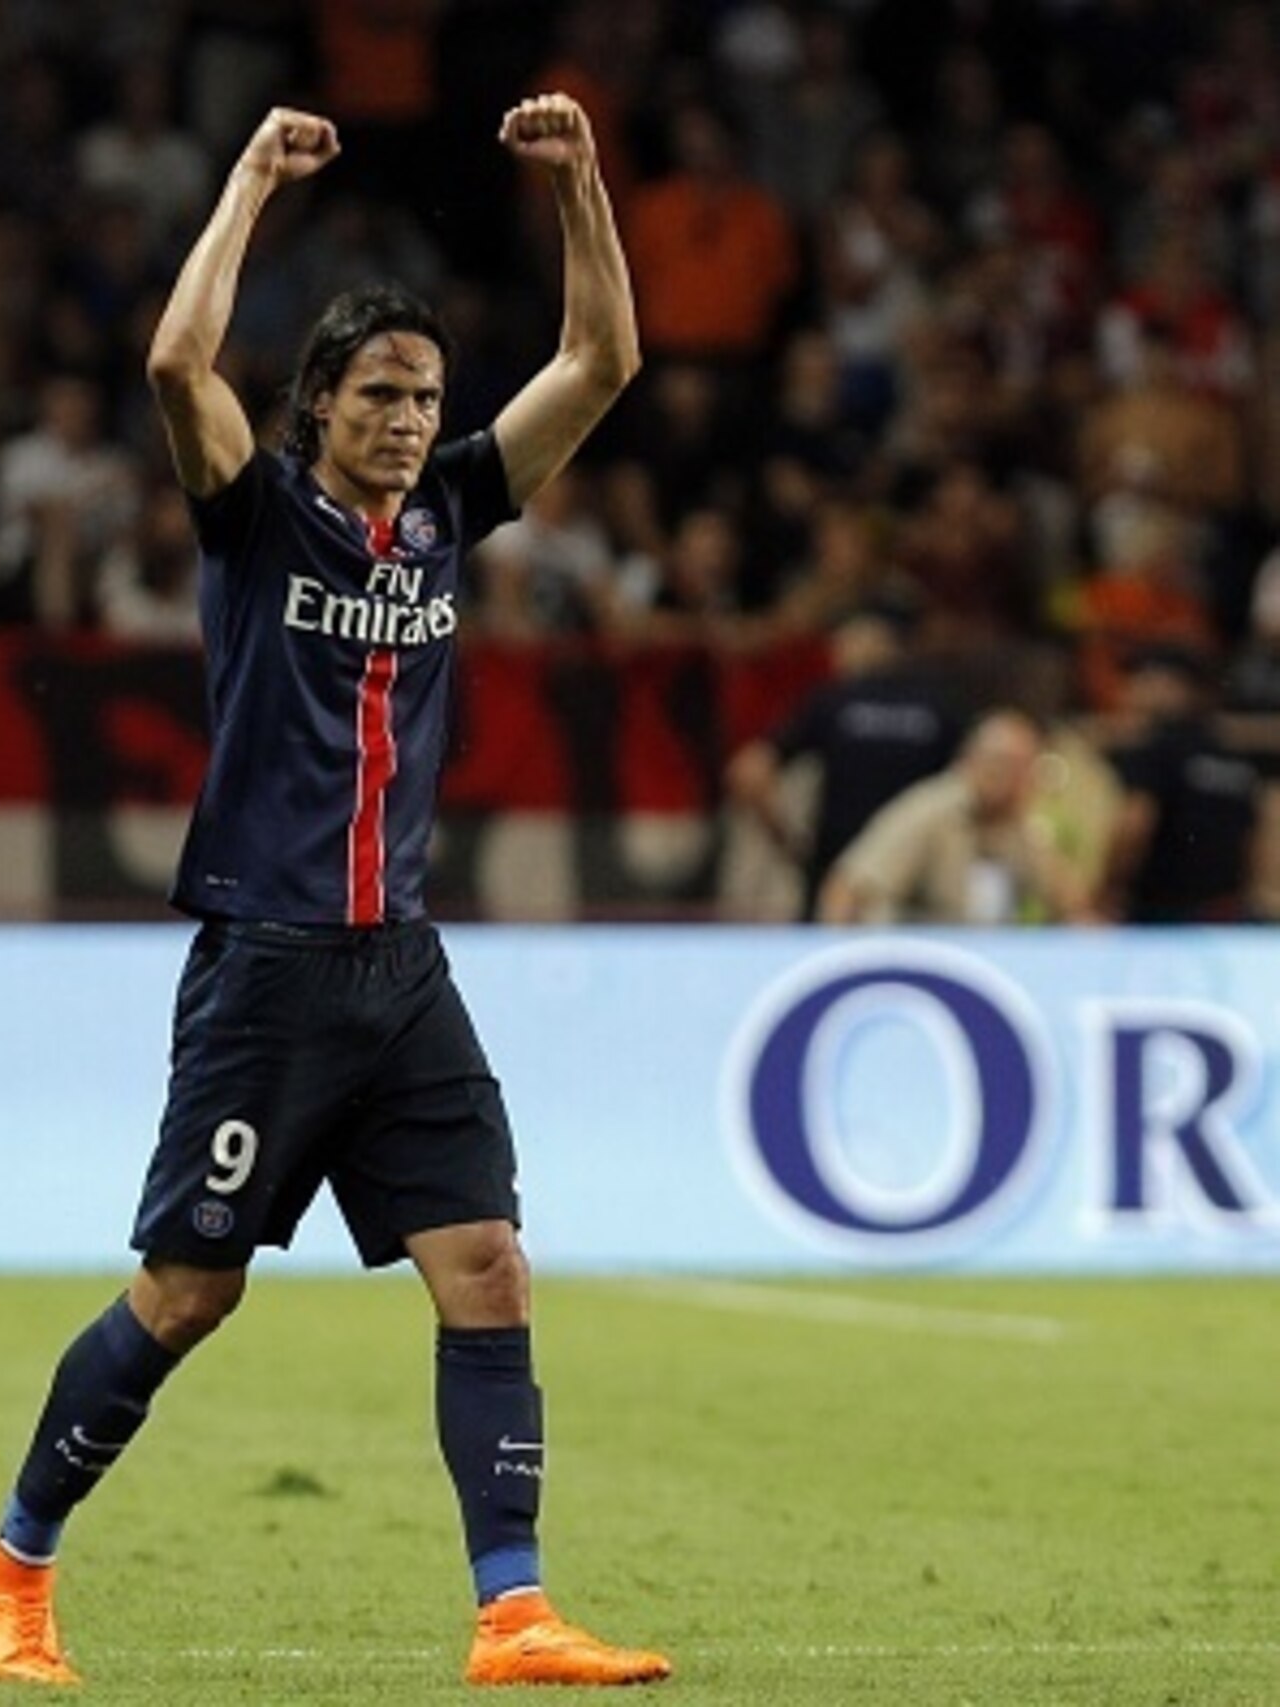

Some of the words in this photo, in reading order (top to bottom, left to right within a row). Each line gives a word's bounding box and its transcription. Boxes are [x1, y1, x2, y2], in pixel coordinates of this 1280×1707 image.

[283, 572, 457, 644] Emiraes
[365, 563, 423, 604] Fly
[206, 1119, 259, 1193] 9
